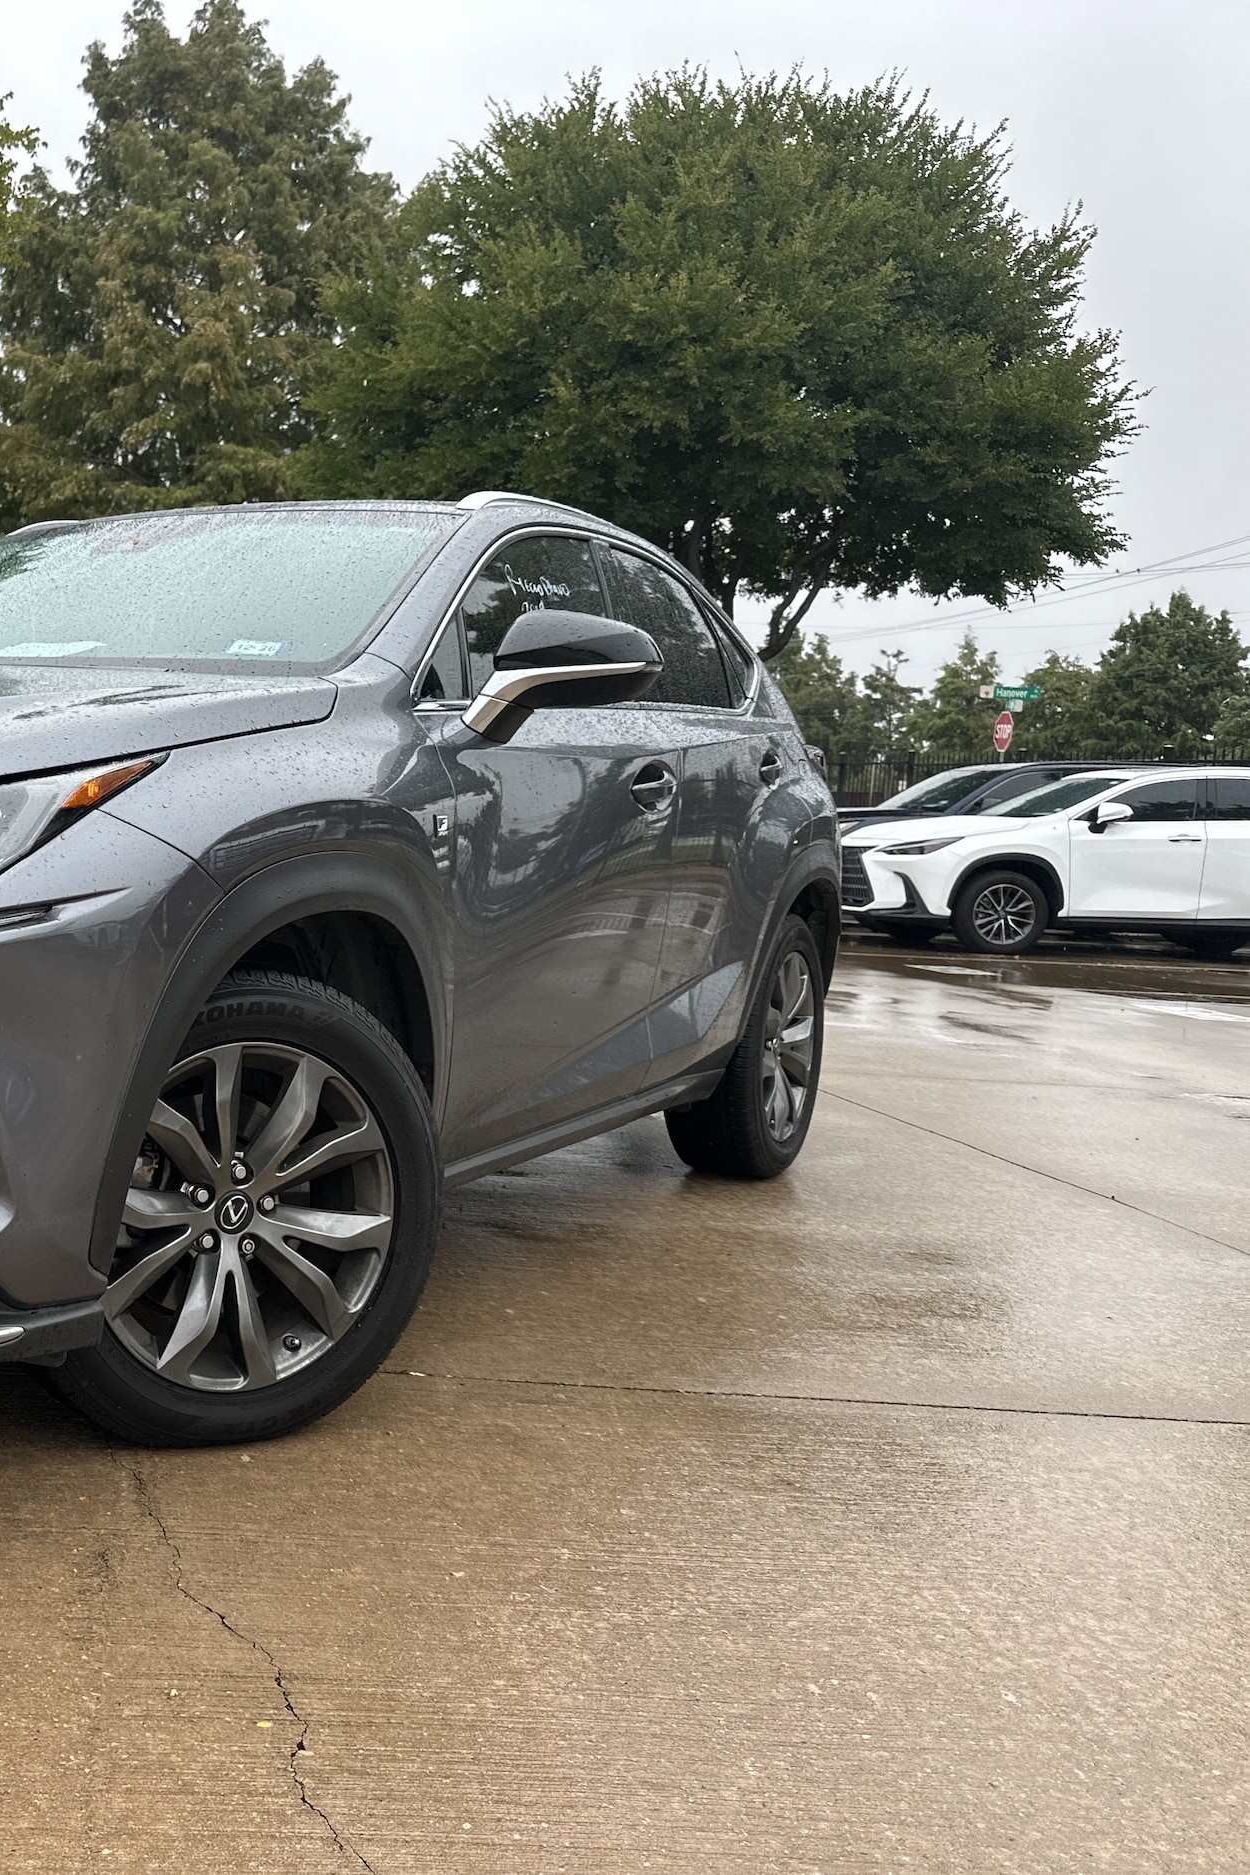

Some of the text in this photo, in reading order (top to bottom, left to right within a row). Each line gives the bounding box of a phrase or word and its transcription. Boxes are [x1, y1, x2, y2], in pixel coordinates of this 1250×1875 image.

[996, 687, 1028, 698] Hanover
[995, 724, 1012, 739] STOP
[196, 1002, 306, 1025] KOHAMA
